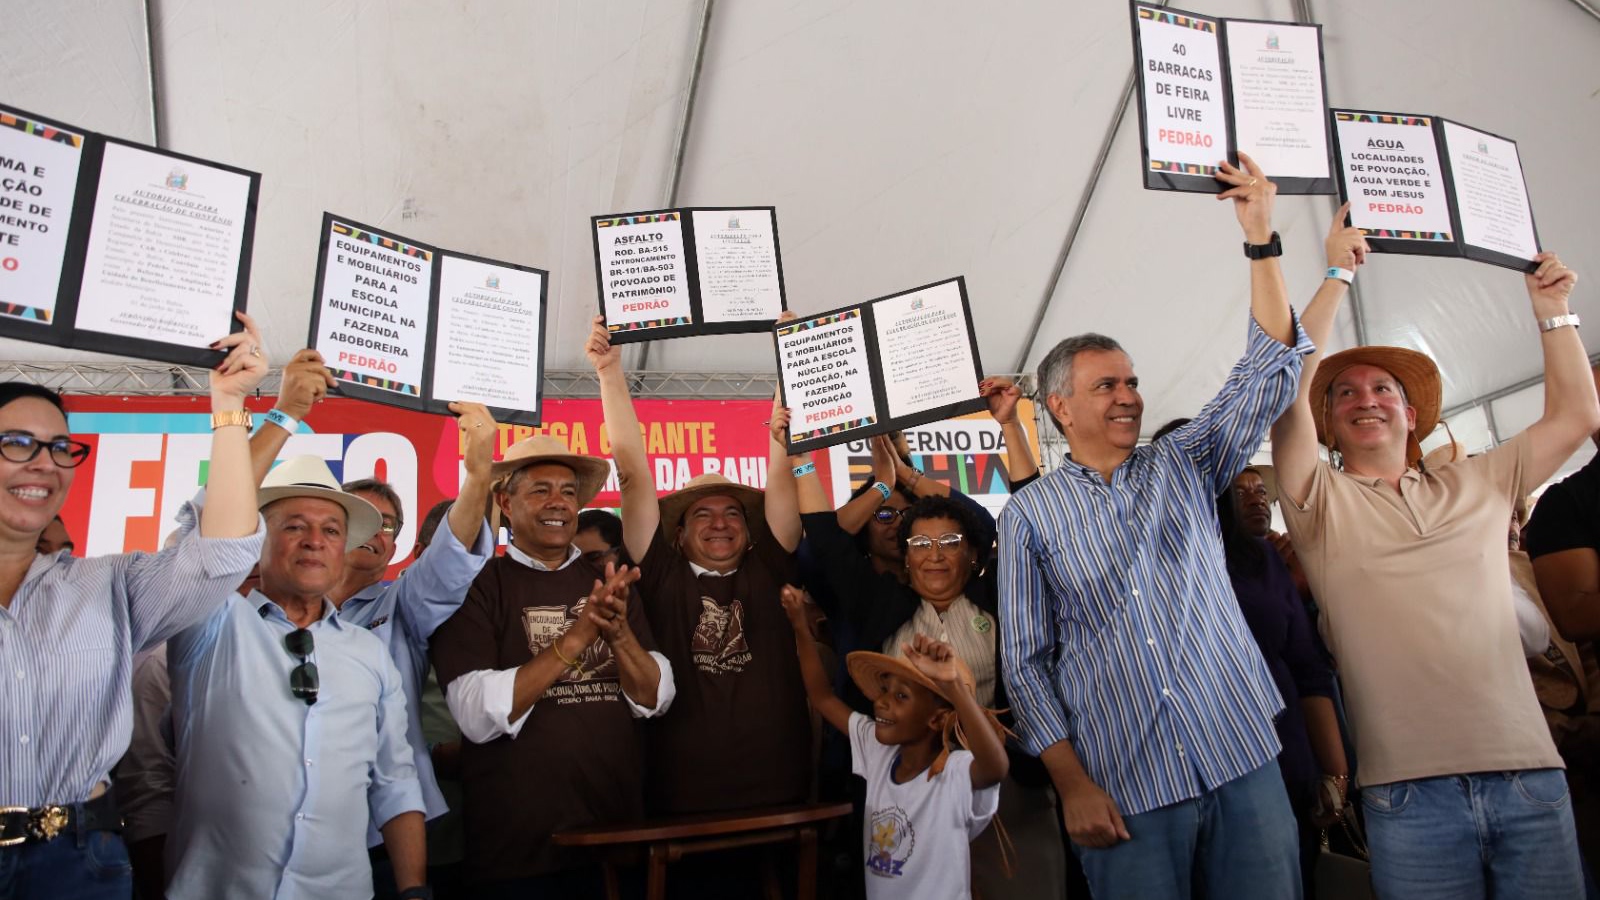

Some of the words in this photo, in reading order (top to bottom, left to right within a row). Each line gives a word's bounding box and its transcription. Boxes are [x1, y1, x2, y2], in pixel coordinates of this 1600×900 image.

[1172, 42, 1186, 56] 40
[1148, 59, 1212, 81] BARRACAS
[1155, 81, 1171, 95] DE
[1175, 85, 1209, 101] FEIRA
[1166, 105, 1201, 121] LIVRE
[1158, 128, 1212, 147] PEDRÃO
[1367, 137, 1404, 149] ÁGUA
[1351, 152, 1424, 163] LOCALIDADES
[33, 166, 45, 178] E
[1350, 163, 1364, 171] DE
[1367, 165, 1429, 176] POVOAÇÃO,
[1352, 174, 1382, 184] ÁGUA
[1385, 178, 1421, 186] VERDE
[1423, 179, 1430, 187] E
[1362, 188, 1387, 196] BOM
[1390, 190, 1424, 198] JESUS
[29, 203, 52, 217] DE
[1368, 202, 1423, 214] PEDRÃO
[614, 232, 663, 244] ASFALTO
[336, 239, 420, 272] EQUIPAMENTOS
[610, 254, 675, 265] ENTRONCAMENTO
[614, 248, 636, 257] ROD.
[638, 244, 668, 254] BA-515
[336, 254, 344, 263] E
[347, 257, 417, 284] MOBILIÁRIOS
[354, 274, 386, 290] PARA
[389, 284, 397, 293] A
[610, 275, 660, 288] (POVOADO
[663, 274, 675, 282] DE
[351, 288, 398, 308] ESCOLA
[611, 285, 676, 298] PATRIMÔNIO)
[329, 298, 397, 323] MUNICIPAL
[400, 316, 415, 328] NA
[622, 299, 669, 312] PEDRÃO
[343, 317, 399, 339] FAZENDA
[784, 325, 853, 348] EQUIPAMENTOS
[329, 331, 408, 357] ABOBOREIRA
[795, 336, 852, 356] MOBILIÁRIOS
[338, 351, 397, 373] PEDRÃO
[786, 357, 810, 369] PARA
[821, 346, 856, 360] ESCOLA
[797, 362, 833, 377] NÚCLEO
[835, 359, 848, 367] DA
[790, 372, 842, 390] POVOAÇÃO,
[845, 367, 857, 376] NA
[805, 381, 846, 397] FAZENDA
[802, 391, 852, 409] POVOAÇÃO
[805, 404, 853, 423] PEDRÃO
[655, 458, 692, 491] DA
[703, 457, 767, 490] BAHI
